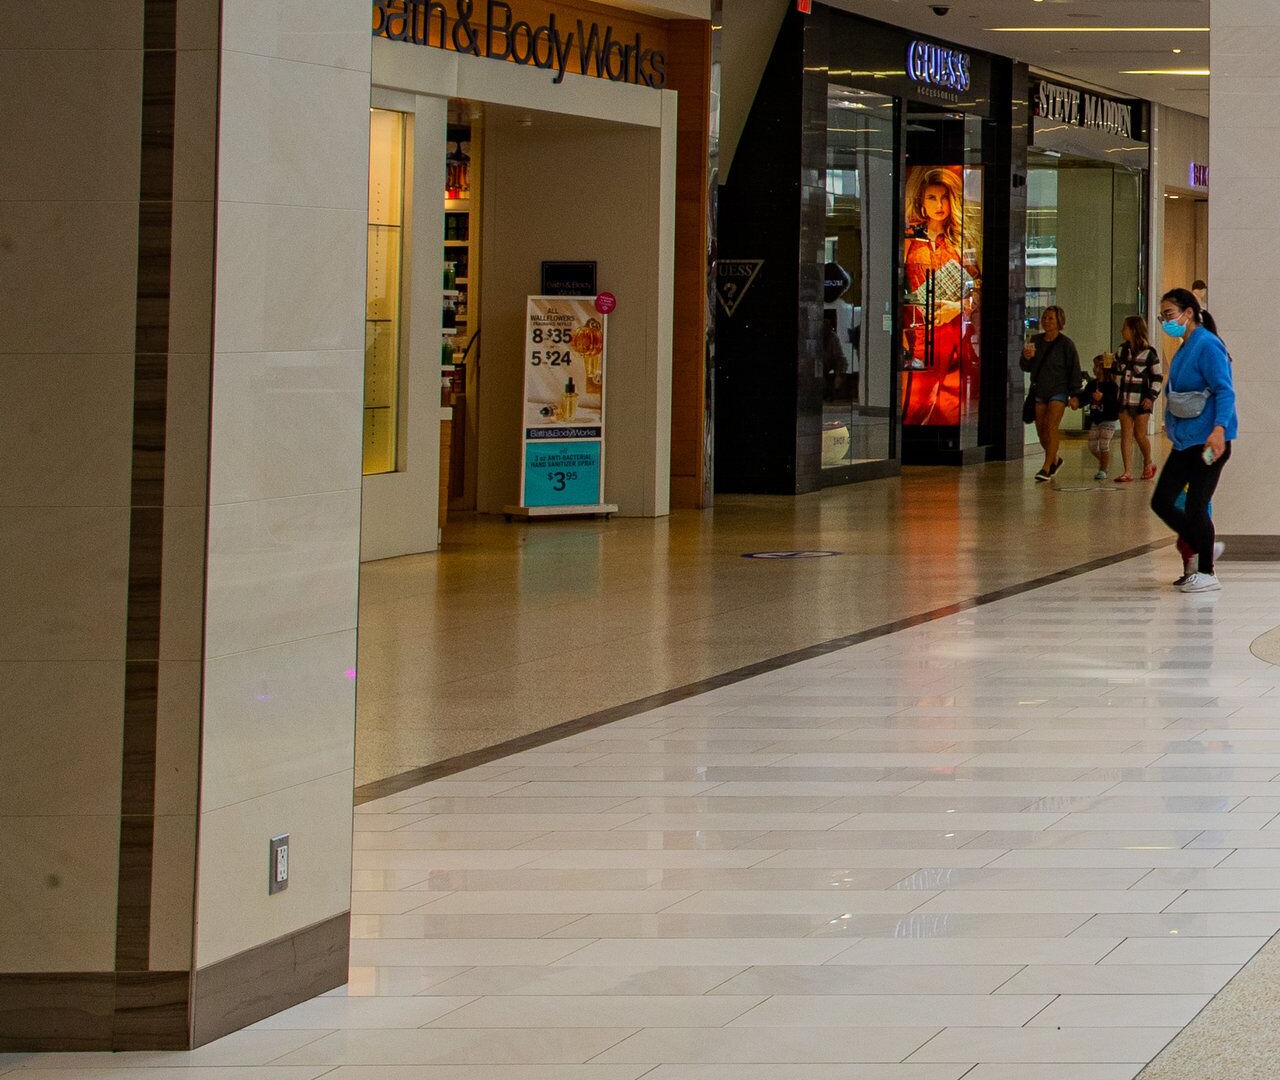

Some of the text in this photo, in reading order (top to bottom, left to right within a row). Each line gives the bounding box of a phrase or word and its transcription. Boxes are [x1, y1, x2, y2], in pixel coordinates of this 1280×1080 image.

[486, 0, 574, 84] Body
[577, 19, 666, 89] Works
[906, 40, 971, 92] GUESS
[917, 87, 958, 103] ACCESSORIES
[1039, 81, 1132, 139] STEVE MADDEN
[1189, 161, 1209, 187] BIK
[532, 328, 572, 344] 8 $35
[531, 351, 572, 366] 5 $24
